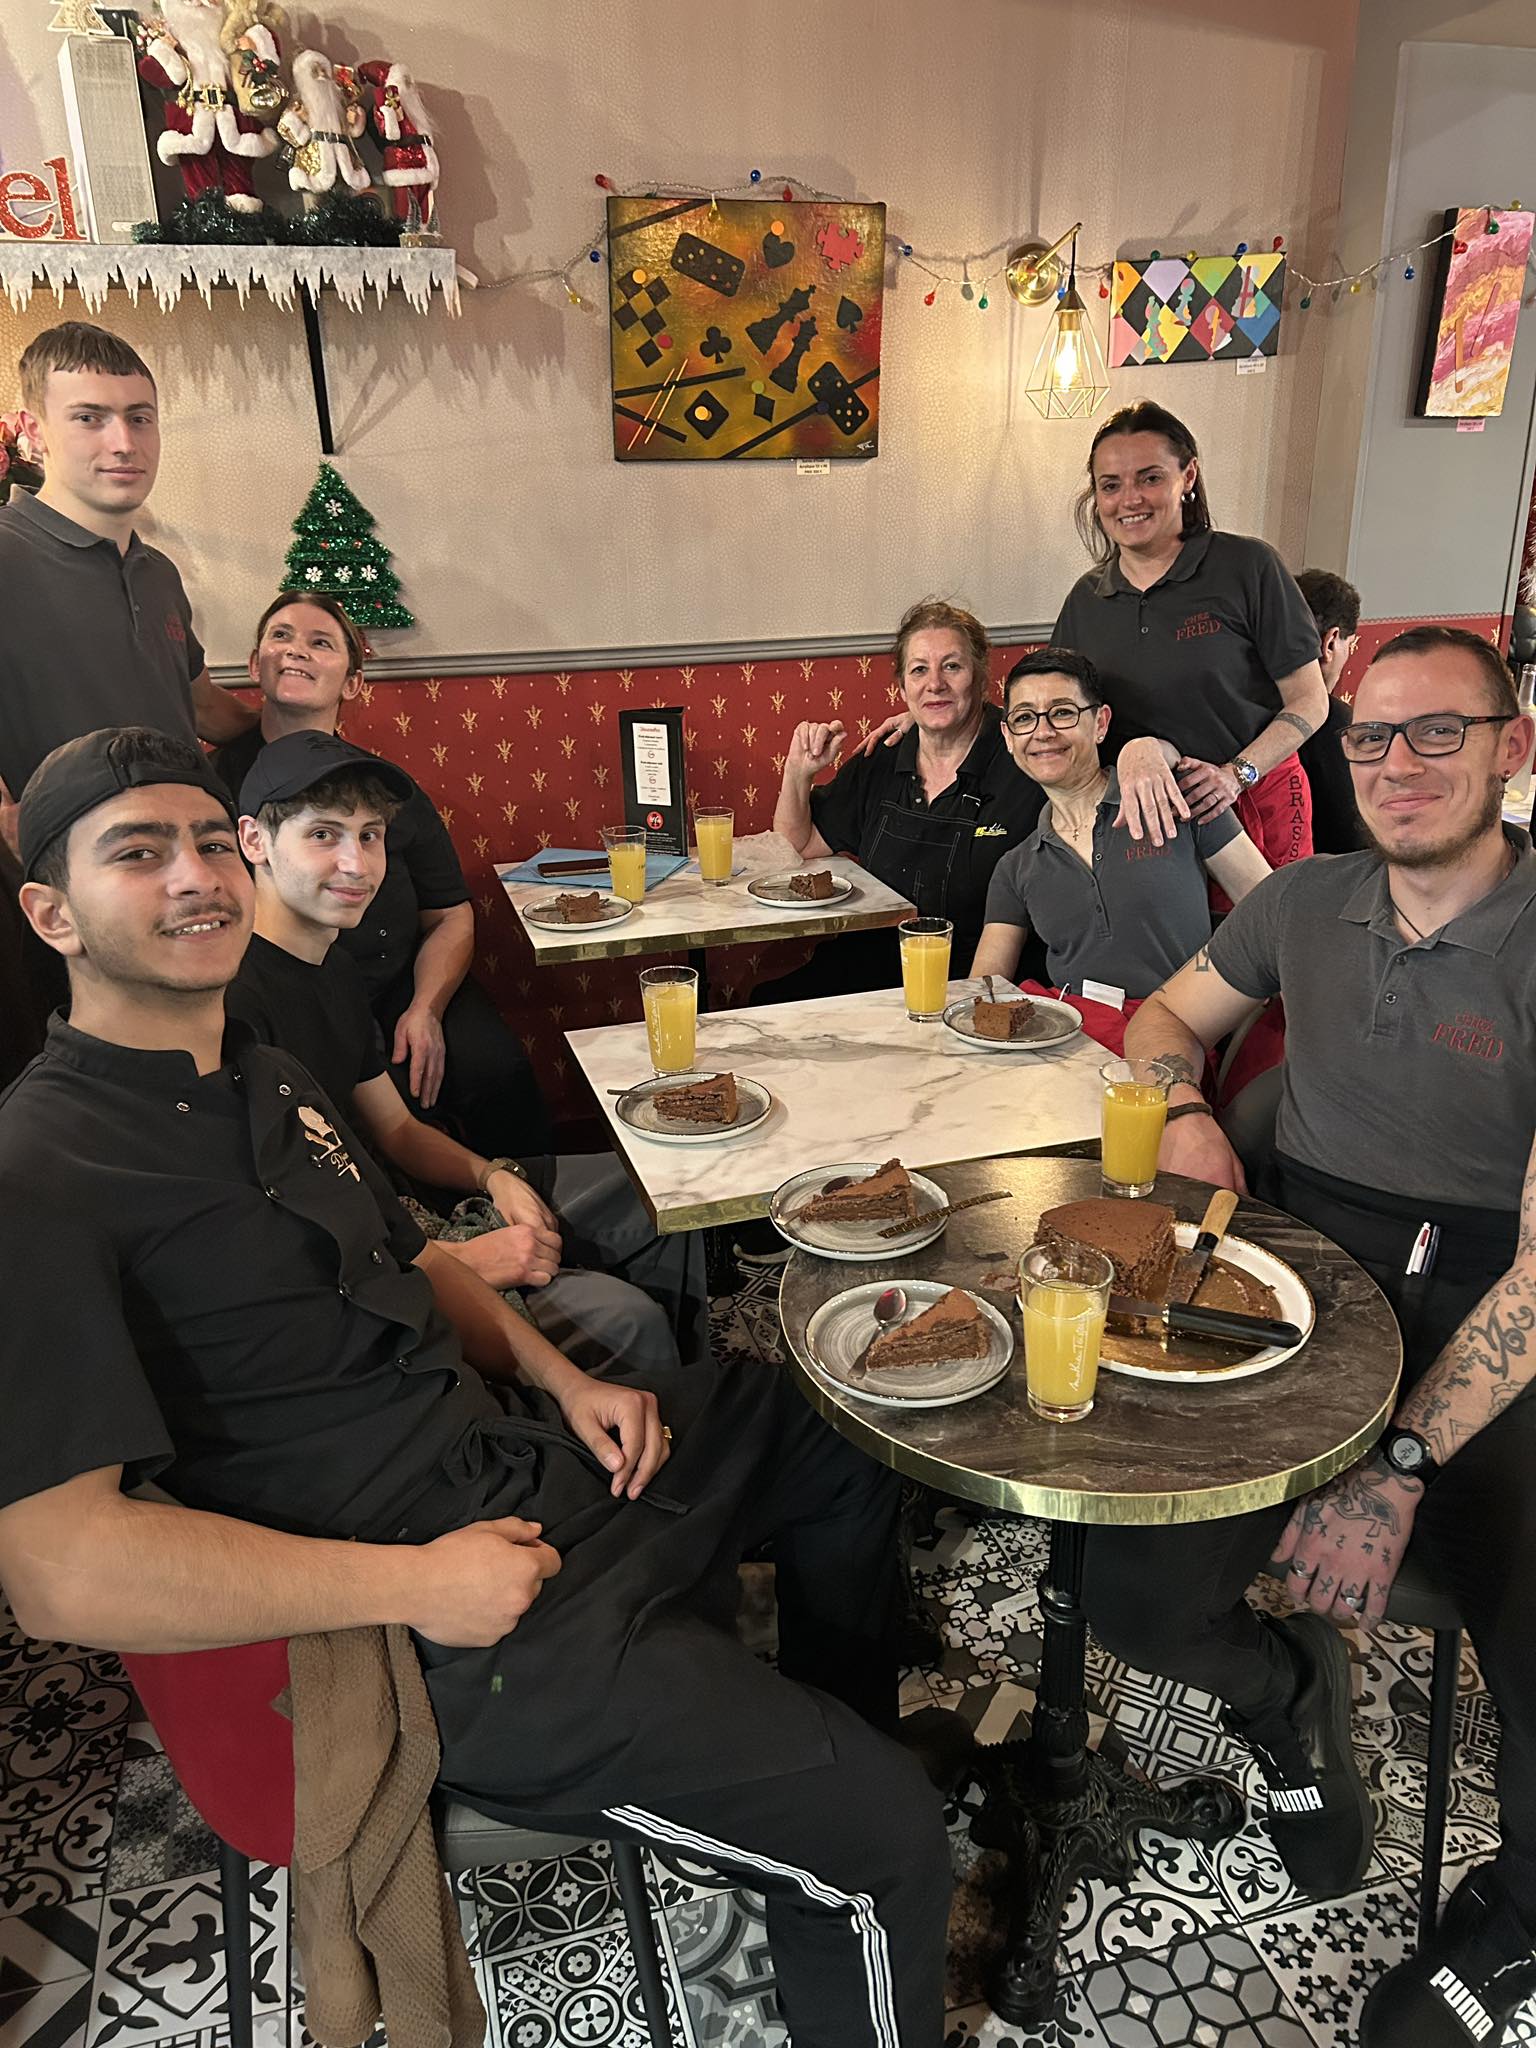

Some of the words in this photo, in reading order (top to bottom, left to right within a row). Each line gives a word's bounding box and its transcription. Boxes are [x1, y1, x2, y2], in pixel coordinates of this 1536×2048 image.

[1176, 620, 1222, 641] FRED
[1289, 775, 1305, 862] BRASS
[1432, 1023, 1504, 1060] FRED
[1268, 1786, 1324, 1812] PUMA
[1429, 1965, 1495, 2042] PUMA
